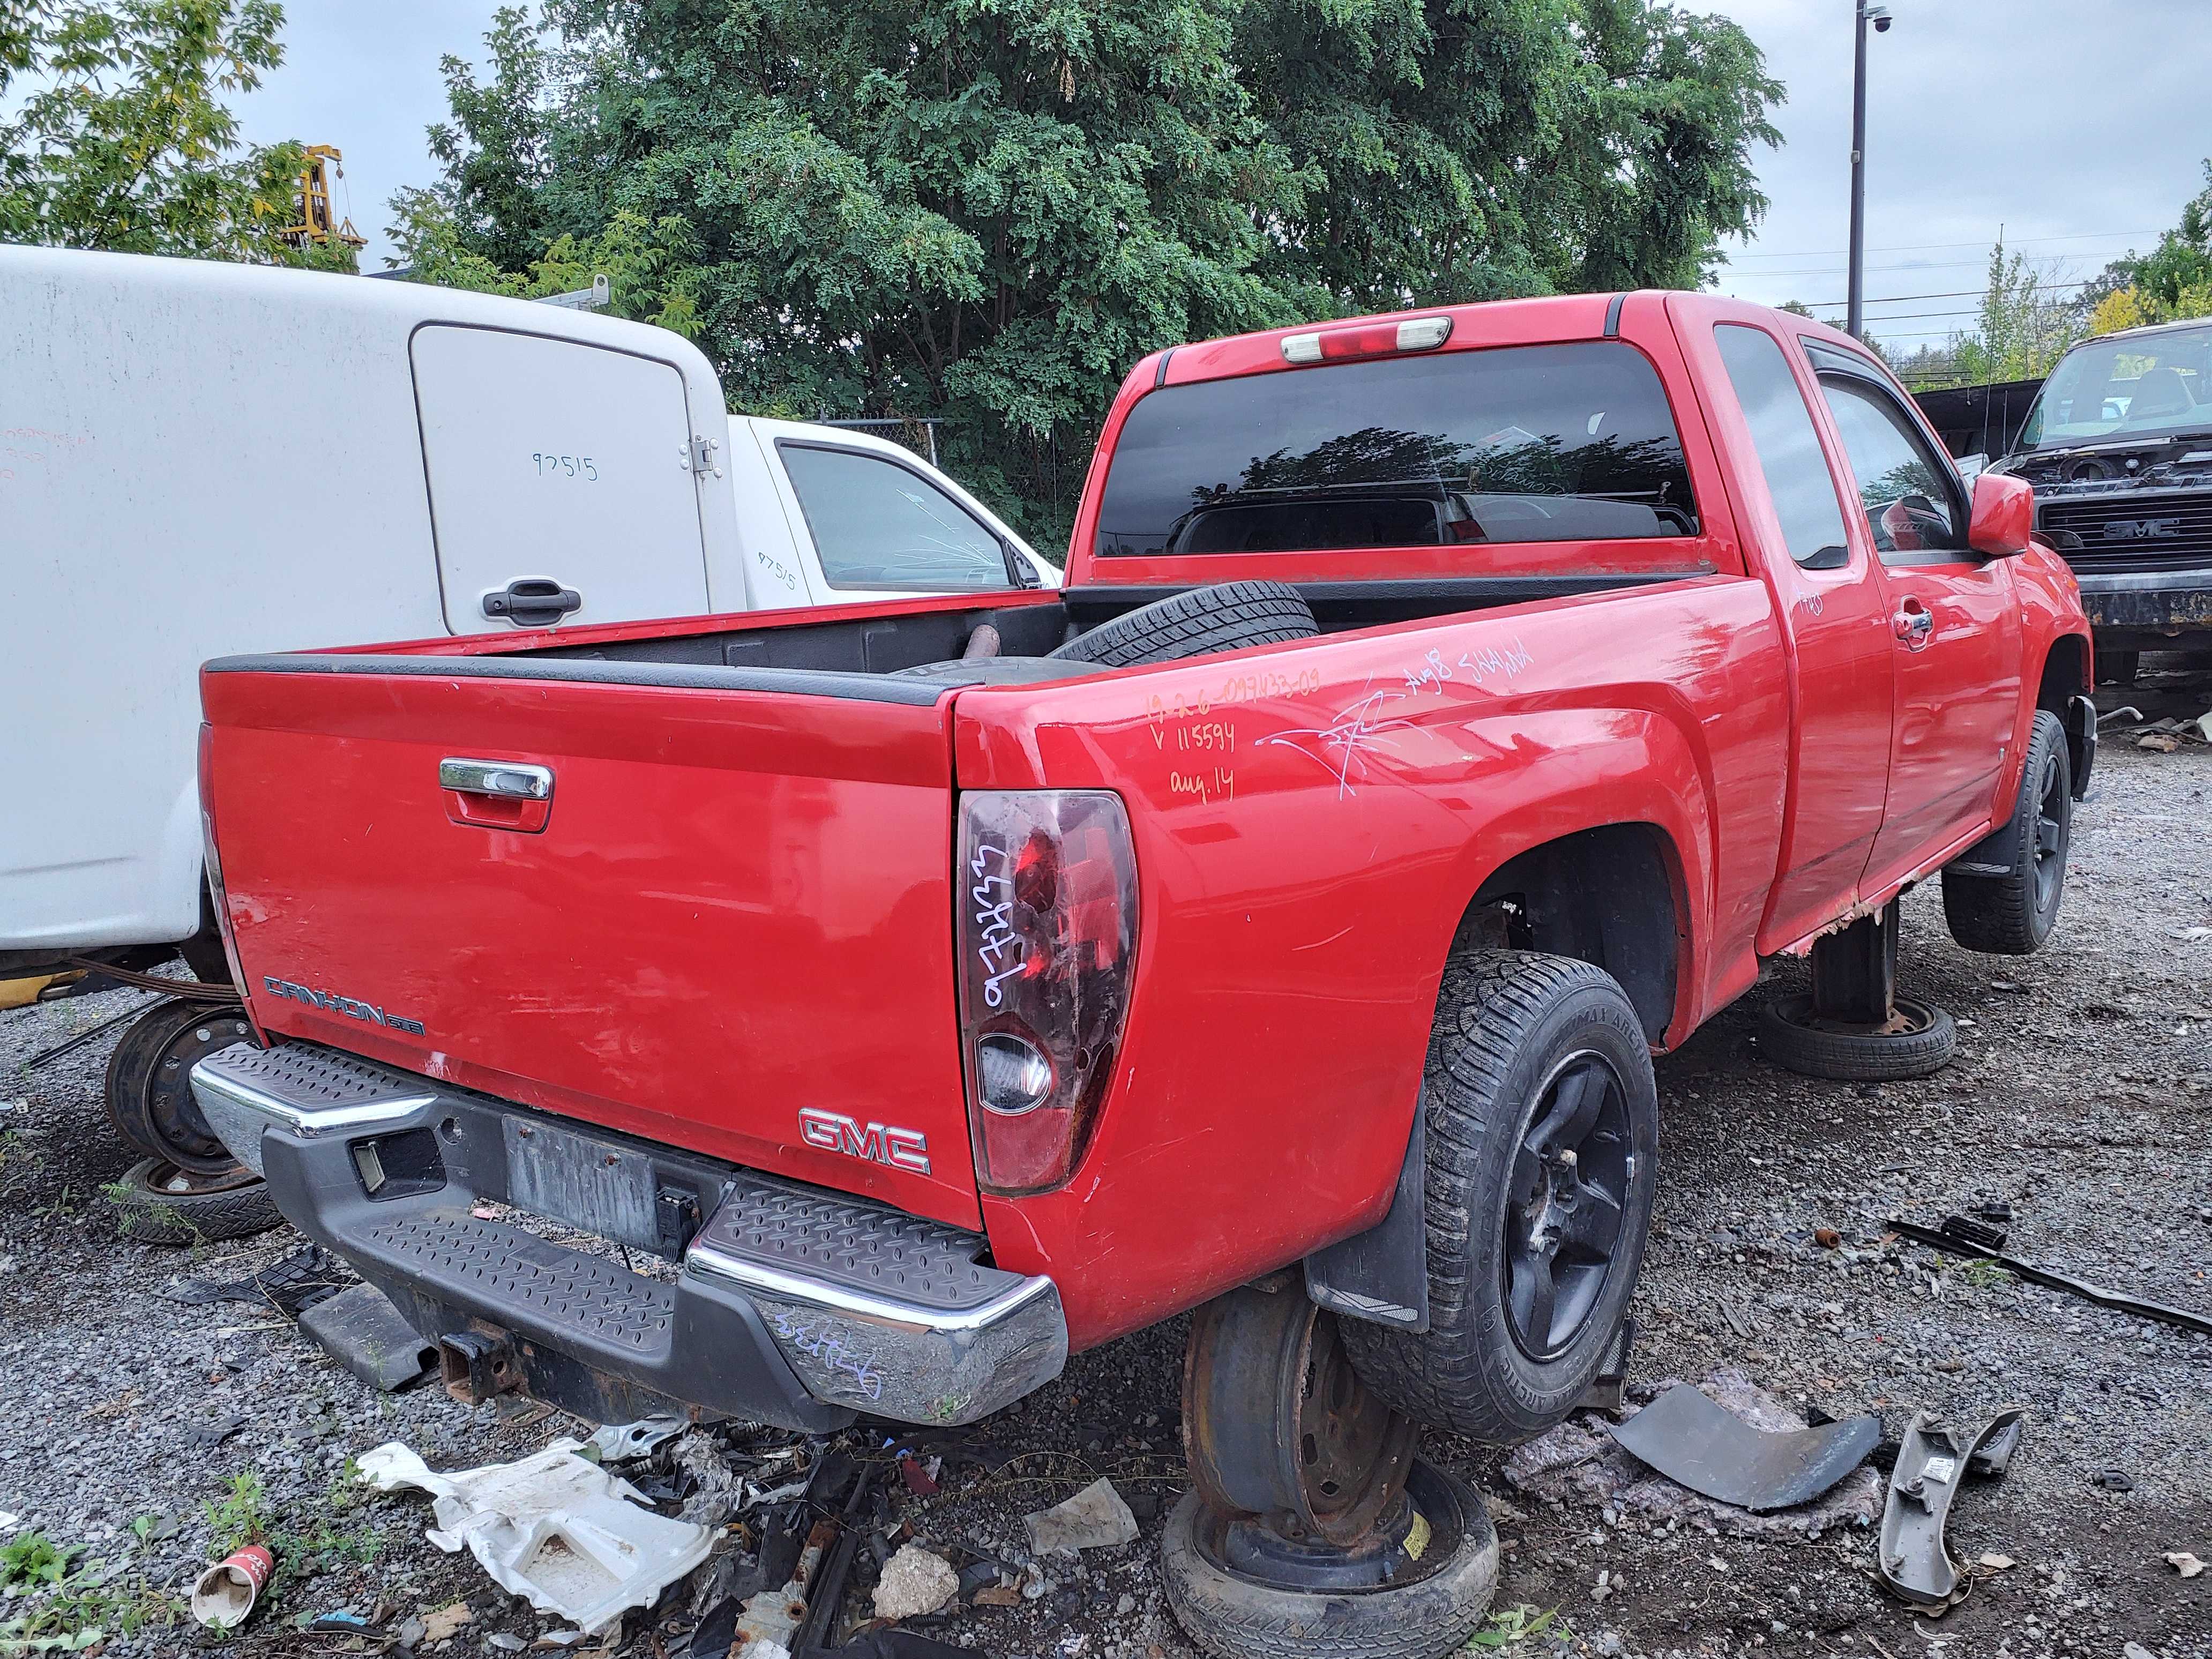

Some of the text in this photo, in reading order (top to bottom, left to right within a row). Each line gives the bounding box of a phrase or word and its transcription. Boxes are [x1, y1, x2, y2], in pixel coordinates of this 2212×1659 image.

[532, 452, 598, 482] 97515
[2103, 518, 2180, 539] GMC
[758, 550, 797, 591] 97515
[1149, 721, 1235, 753] V 115594
[263, 974, 387, 1028] CANYON
[797, 1107, 932, 1176] GMC
[1500, 1356, 1548, 1411] ARCTIC
